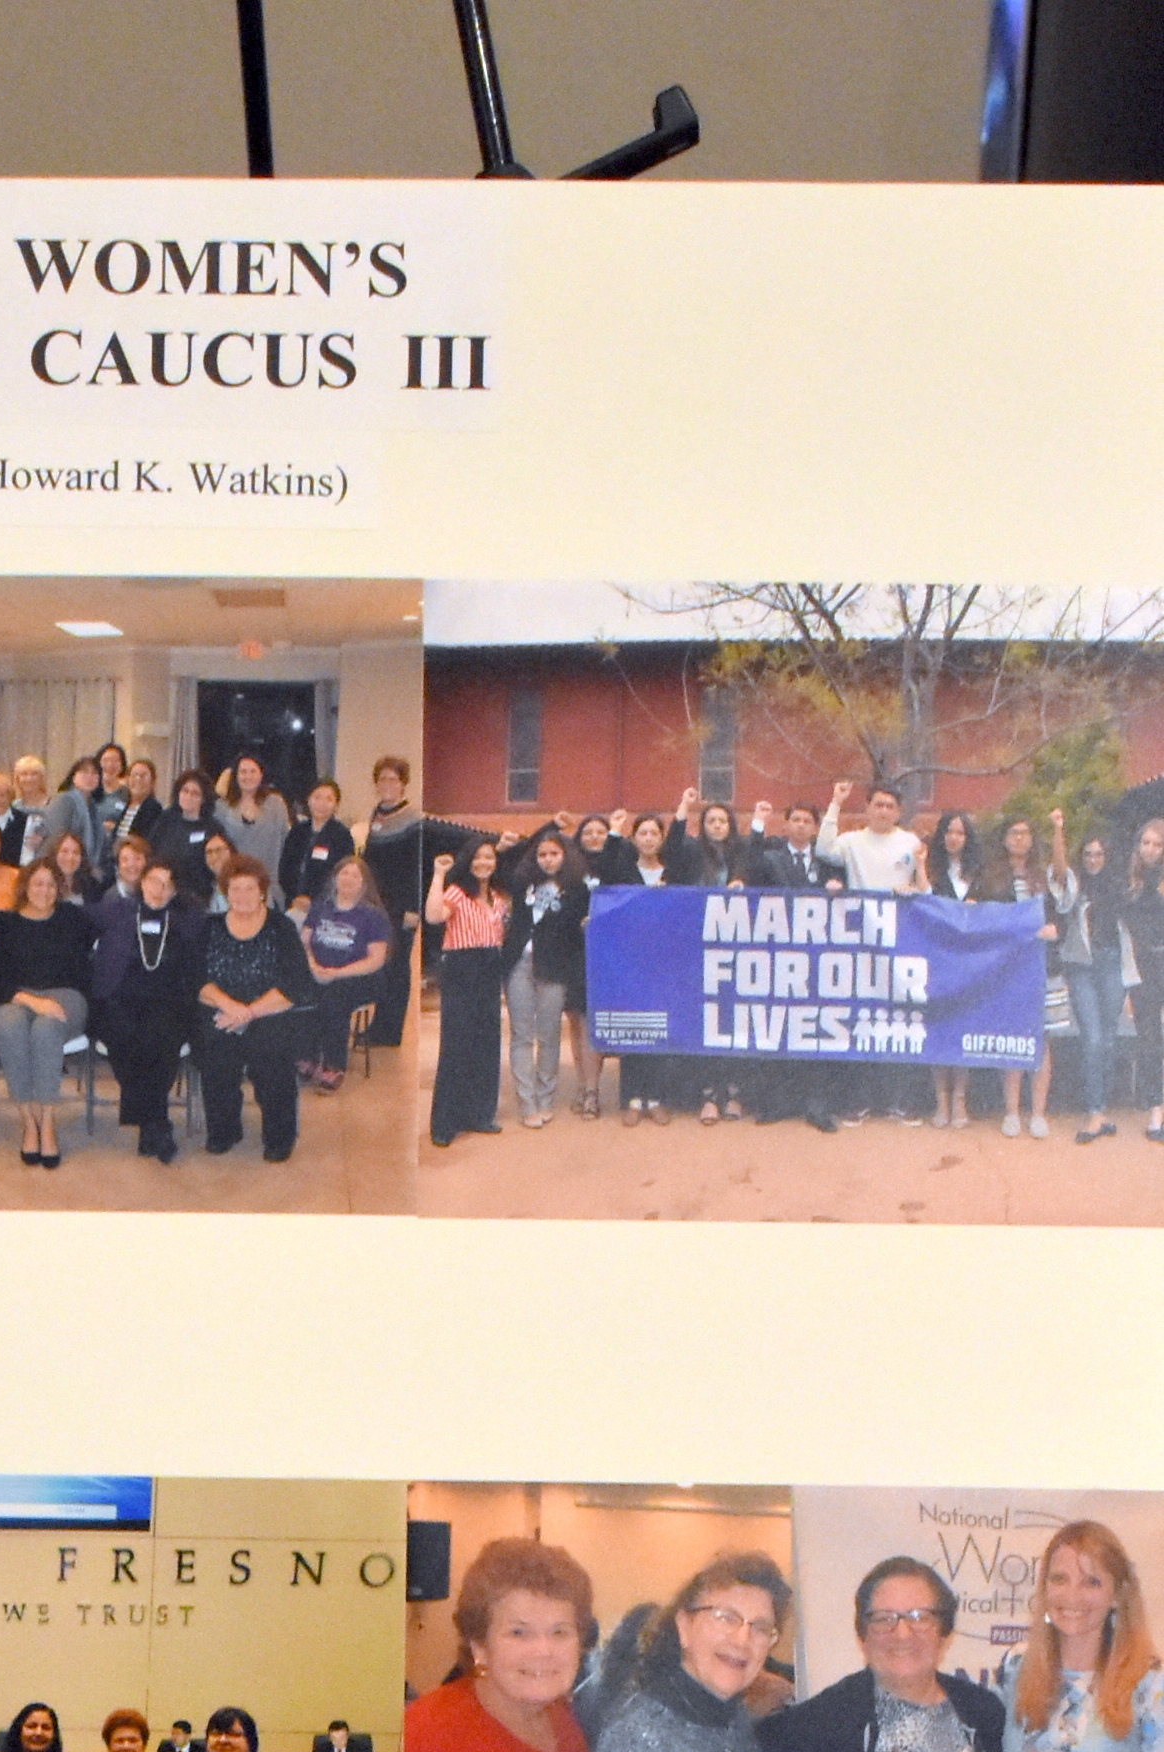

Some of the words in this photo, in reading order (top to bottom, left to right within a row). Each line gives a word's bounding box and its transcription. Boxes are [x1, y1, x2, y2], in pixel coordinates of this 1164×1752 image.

[14, 238, 408, 298] WOMEN’S
[30, 329, 358, 390] CAUCUS
[399, 334, 492, 390] III
[135, 460, 173, 494] K.
[189, 461, 349, 505] Watkins)
[702, 894, 897, 948] MARCH
[702, 948, 810, 998] FOR
[818, 951, 929, 1005] OUR
[702, 1001, 852, 1053] LIVES
[962, 1033, 1036, 1055] GIFFORDS
[919, 1502, 1009, 1530] National
[57, 1547, 396, 1588] FRESNO
[3, 1603, 49, 1624] WE
[77, 1604, 196, 1626] TRUST
